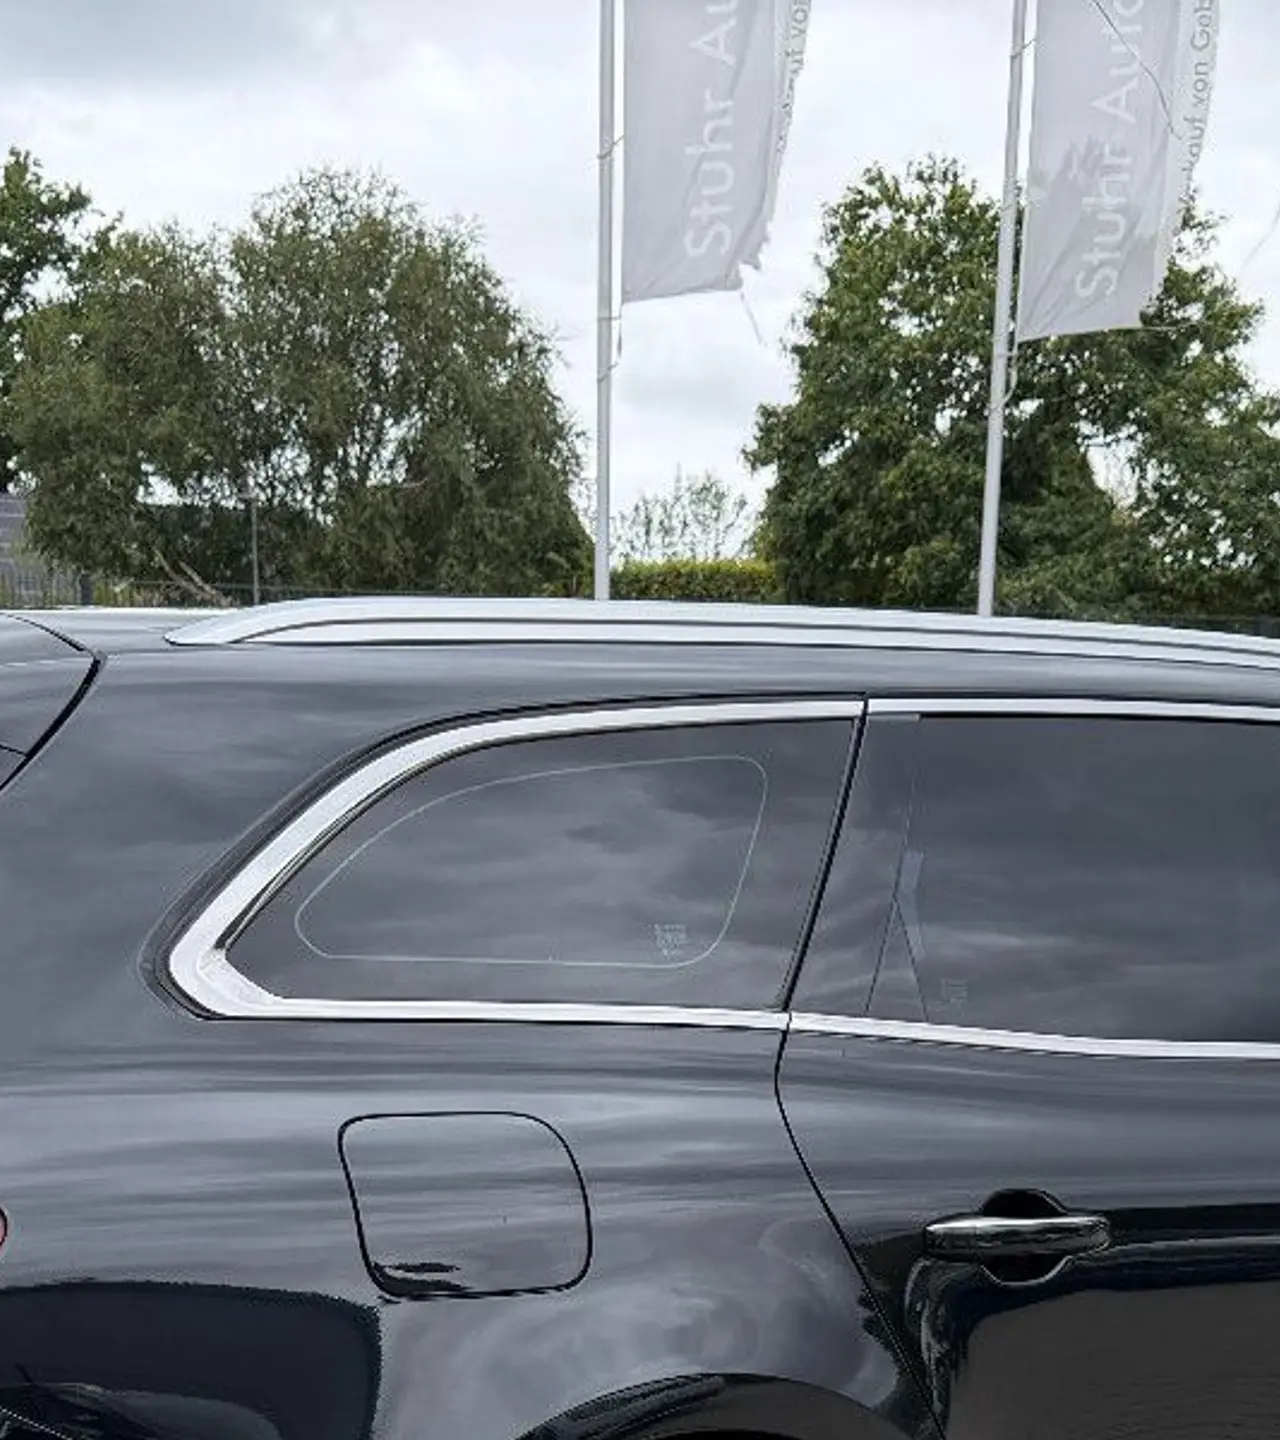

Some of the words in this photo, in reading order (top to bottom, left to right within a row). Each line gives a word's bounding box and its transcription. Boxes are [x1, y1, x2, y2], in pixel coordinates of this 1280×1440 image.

[1191, 61, 1210, 108] von
[683, 87, 735, 259] Stuhr
[1074, 144, 1132, 300] Stuhr
